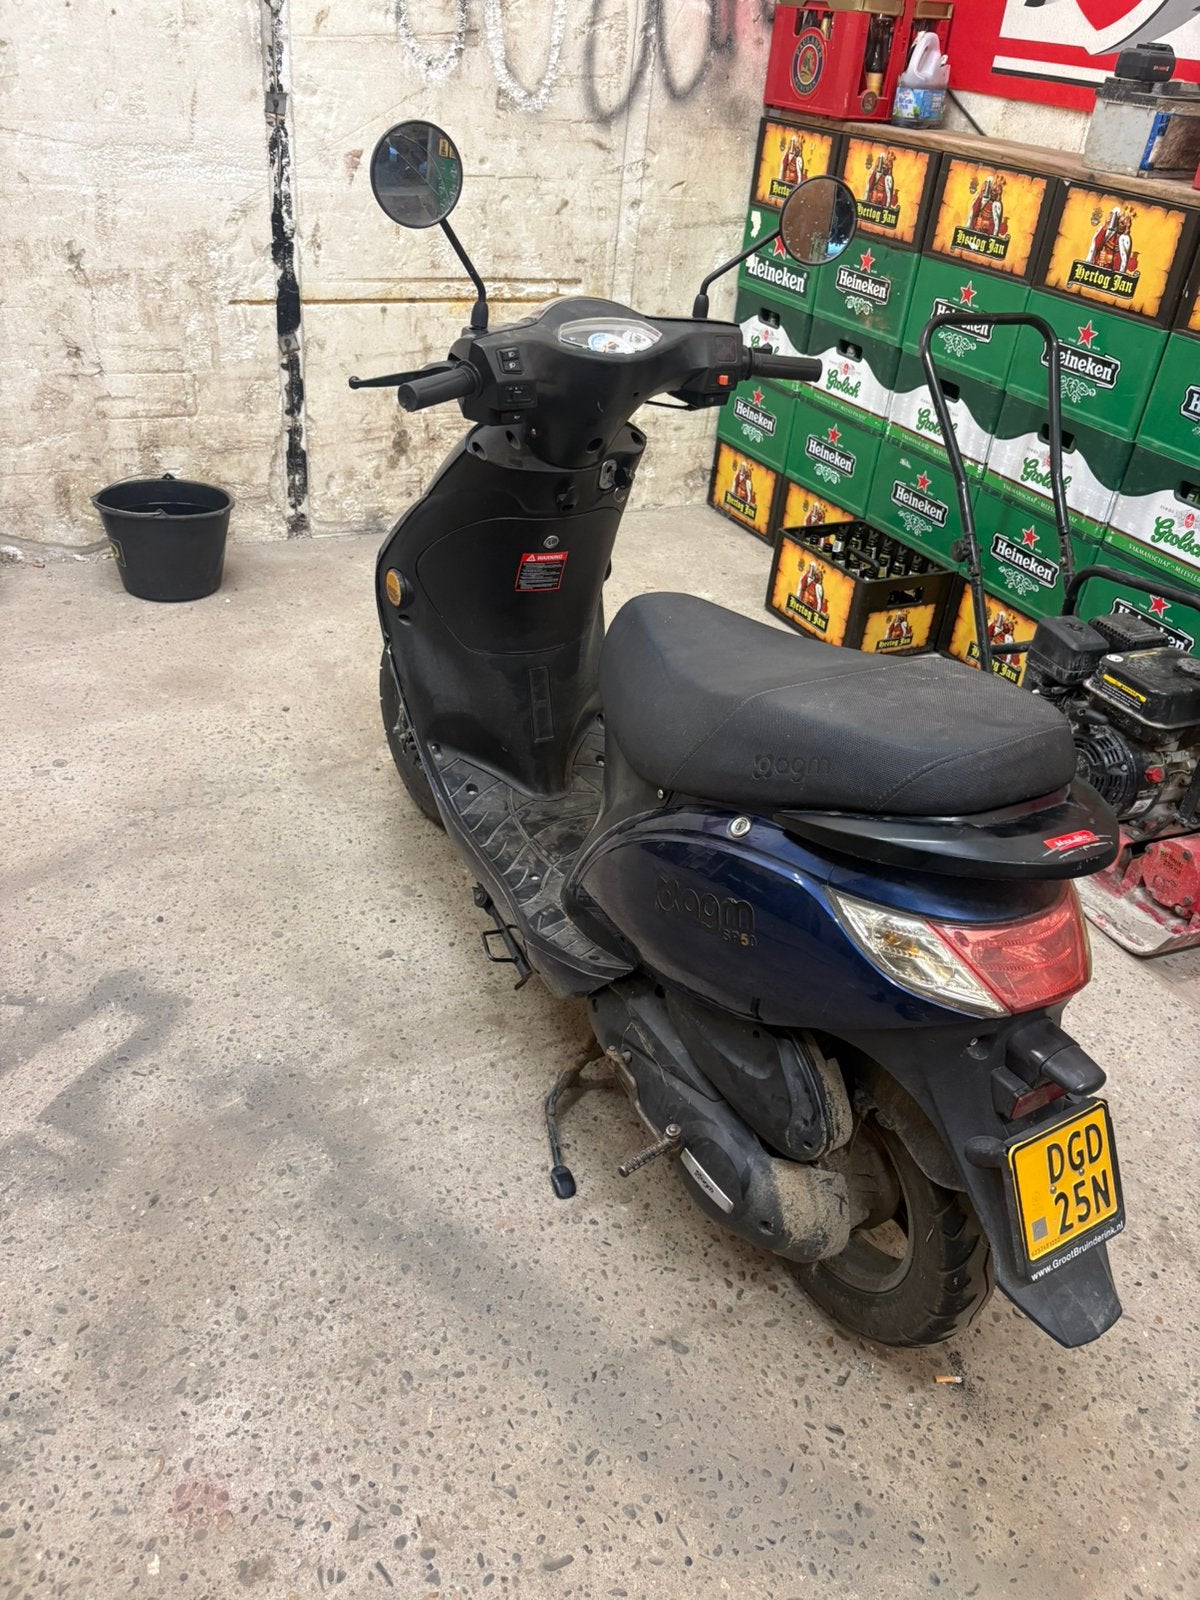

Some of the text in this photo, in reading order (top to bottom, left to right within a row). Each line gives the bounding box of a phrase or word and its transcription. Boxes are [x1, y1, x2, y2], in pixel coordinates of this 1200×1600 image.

[772, 181, 791, 196] Herto
[857, 202, 896, 225] Hertog Jan
[956, 229, 1005, 255] Hertog Jan
[838, 269, 887, 299] Heineken
[1074, 264, 1133, 294] Hertog Jan
[1059, 350, 1112, 381] eineken
[826, 368, 861, 398] Grolsch
[736, 401, 773, 431] Heineken
[808, 439, 852, 472] Heineken
[895, 486, 943, 521] Heineken
[1150, 516, 1200, 558] Grolsc
[995, 539, 1052, 582] Heineken
[1129, 543, 1171, 567] VAKMANSCHAP
[789, 596, 826, 630] Hertog Jan
[1000, 663, 1017, 681] Jan
[1046, 1123, 1103, 1185] DGD
[1054, 1169, 1112, 1236] 25N
[1030, 1220, 1124, 1282] www.GrootBruinderink.nl
